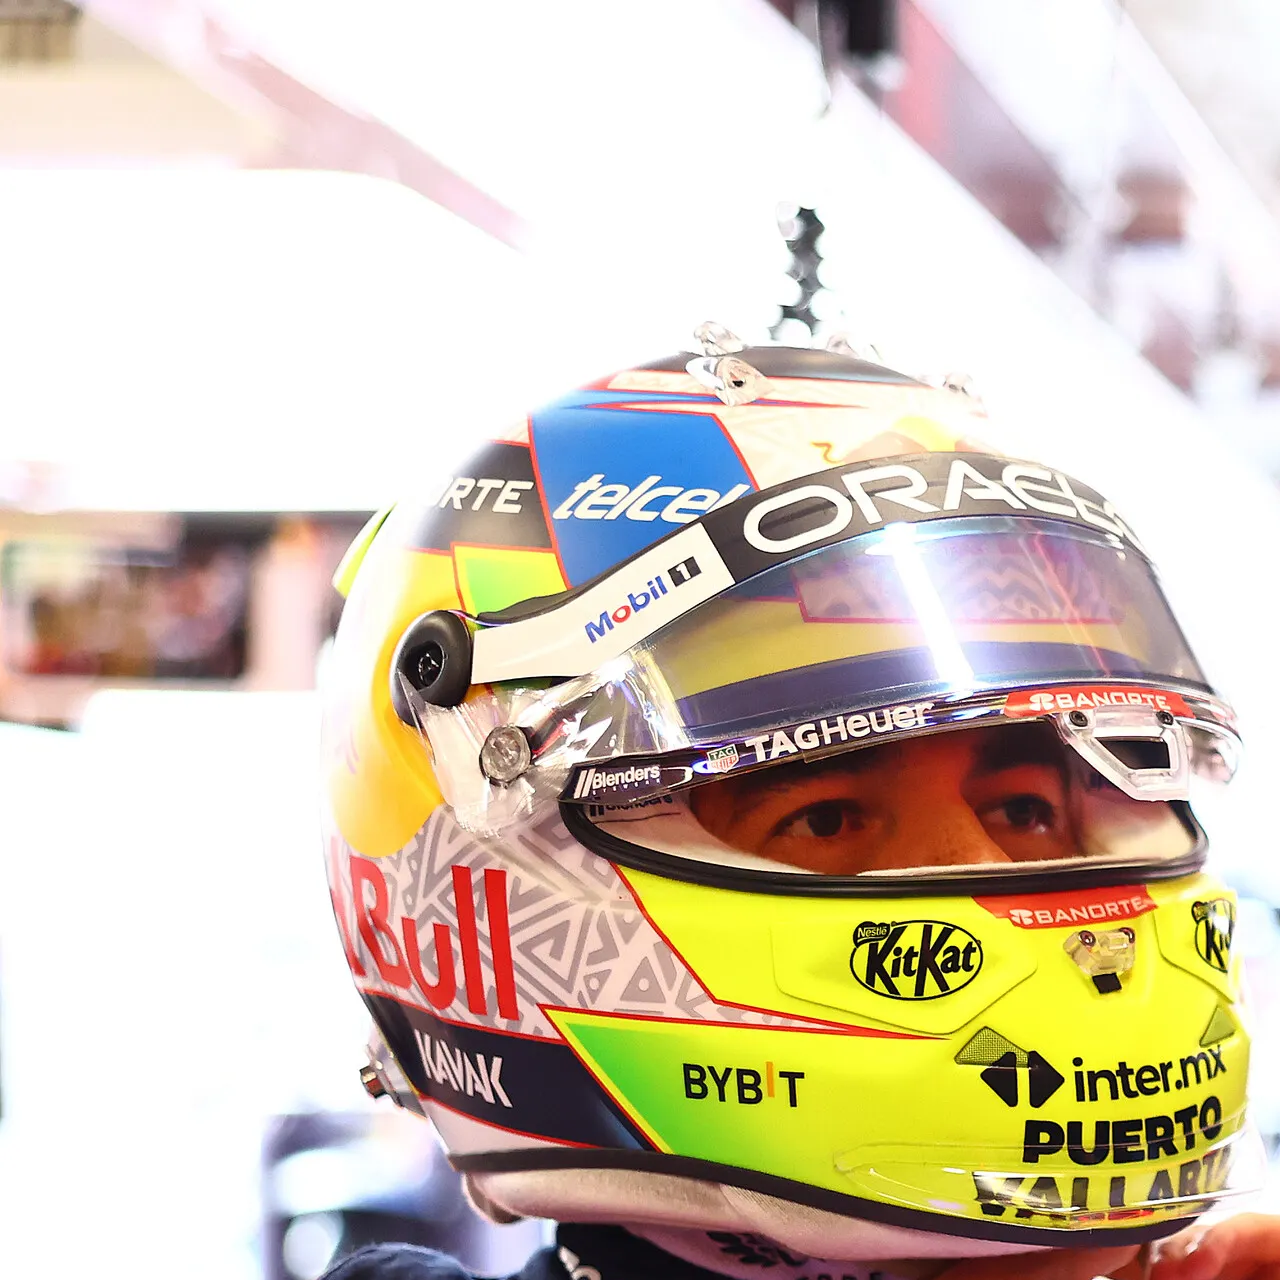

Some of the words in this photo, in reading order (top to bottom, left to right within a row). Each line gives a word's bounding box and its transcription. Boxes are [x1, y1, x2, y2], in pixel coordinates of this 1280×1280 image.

[552, 474, 750, 524] telcel
[585, 575, 669, 643] Mobil
[592, 765, 660, 790] Blenders
[710, 747, 735, 761] TAG
[1034, 896, 1147, 925] BANORTE
[414, 1029, 514, 1109] KAVAK
[682, 1061, 806, 1108] BYBIT
[1071, 1044, 1228, 1103] inter.mx
[1022, 1096, 1222, 1166] PUERTO
